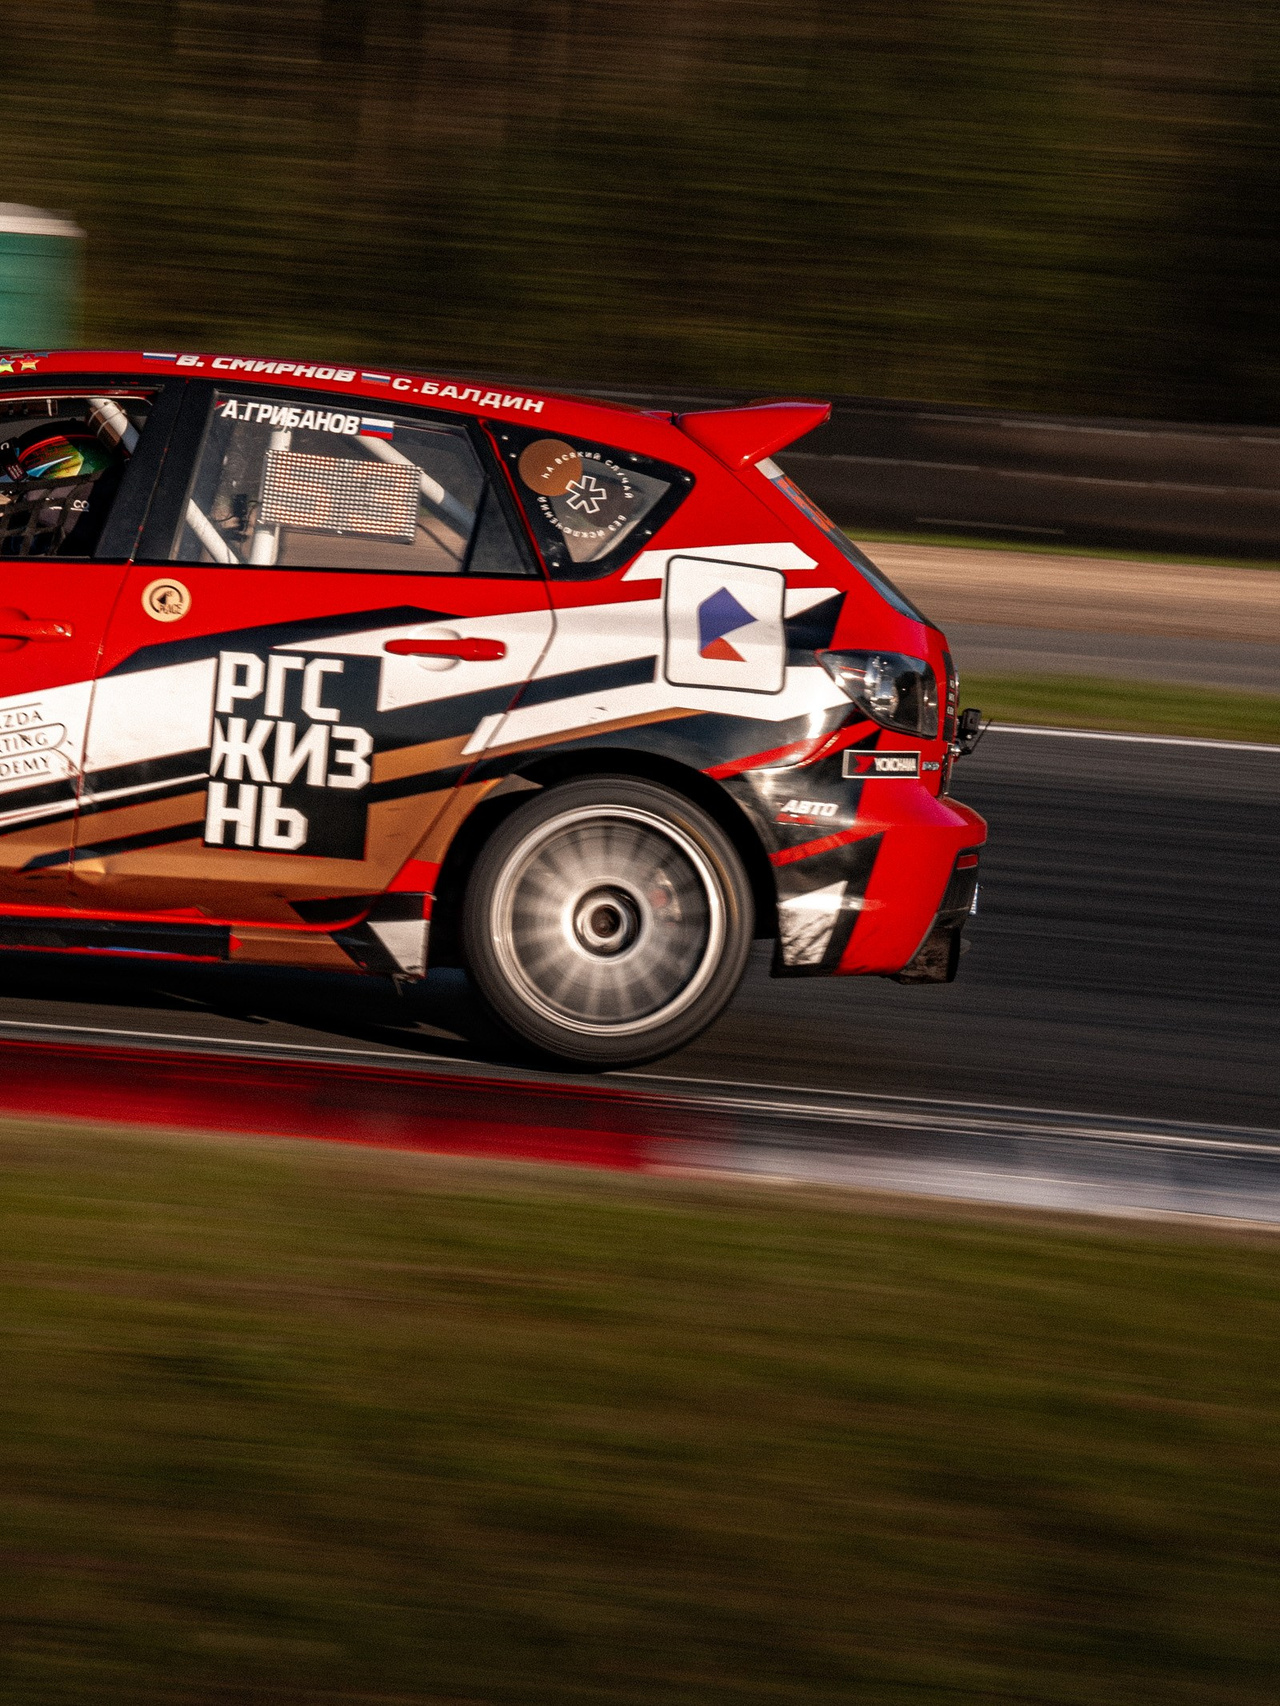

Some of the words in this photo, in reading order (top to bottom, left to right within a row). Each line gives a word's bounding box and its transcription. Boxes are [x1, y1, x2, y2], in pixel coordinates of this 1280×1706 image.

[176, 354, 205, 367] В.
[211, 357, 357, 383] СМИРНОВ
[221, 399, 362, 436] А.ГРИБАНОВ
[215, 650, 345, 722] РГС
[209, 717, 374, 790] ЖИЗ
[204, 780, 309, 851] НЬ
